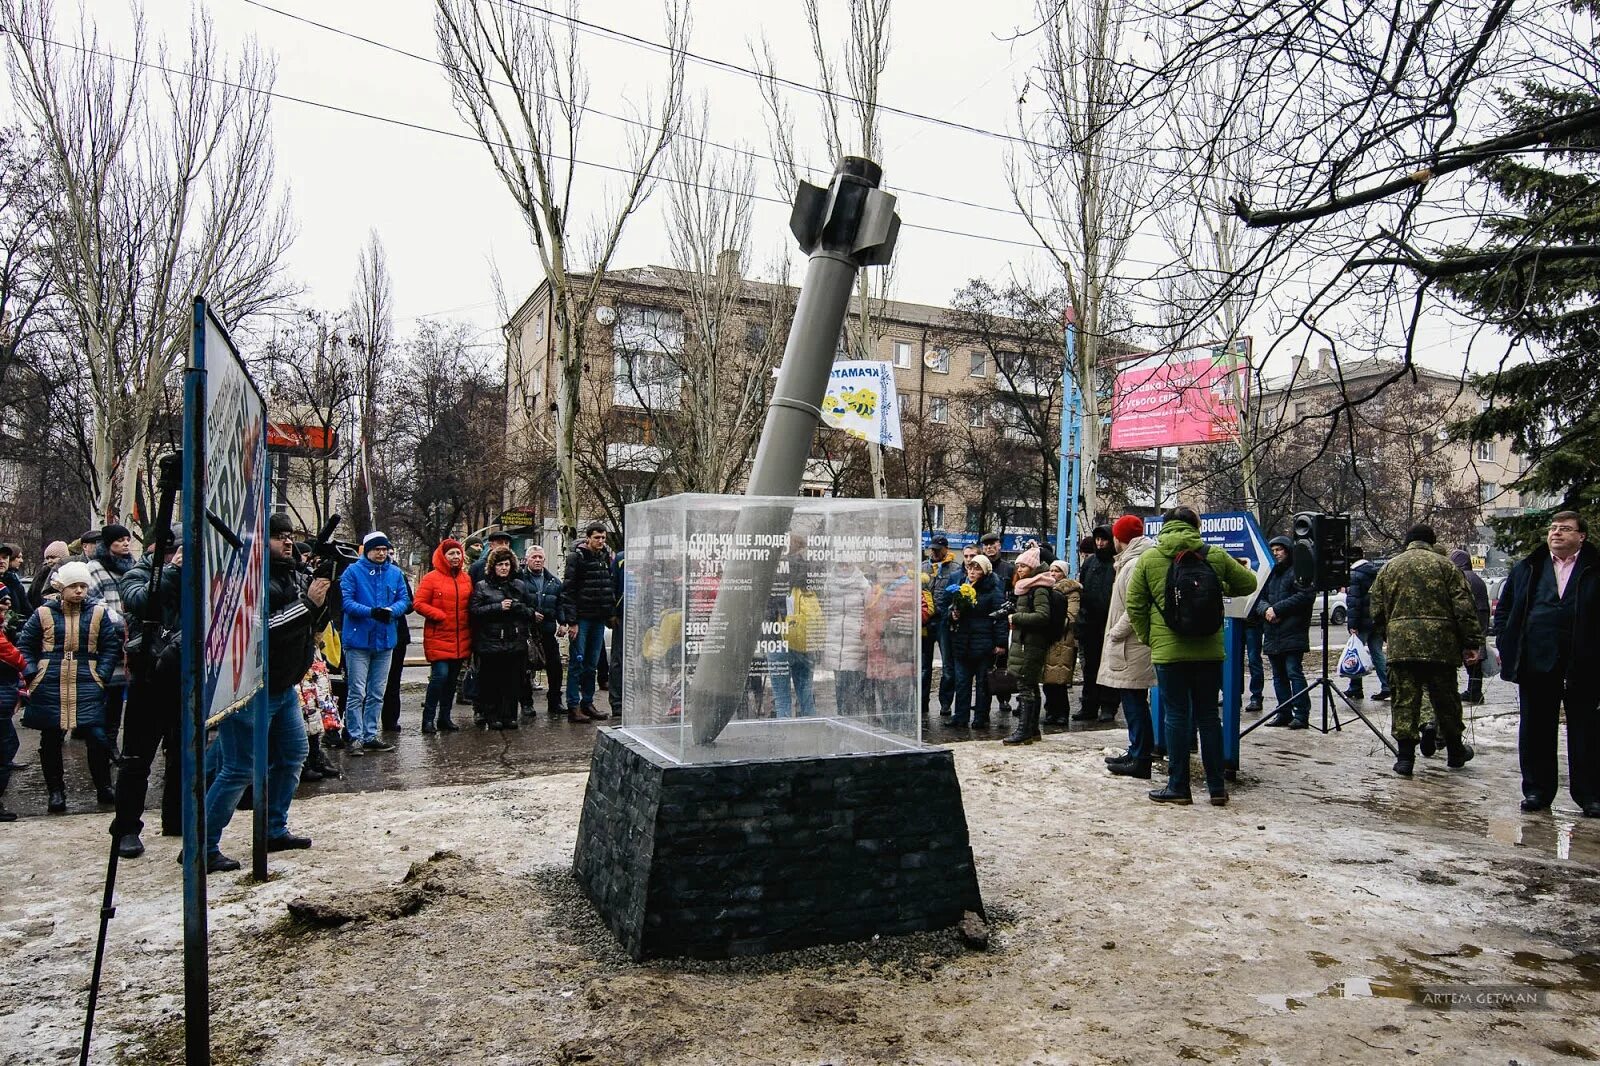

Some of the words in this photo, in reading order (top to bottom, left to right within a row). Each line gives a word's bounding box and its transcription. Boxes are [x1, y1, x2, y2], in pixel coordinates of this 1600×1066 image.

[1200, 517, 1244, 534] ВОКАТОВ
[690, 533, 733, 545] СКІЛЬКИ
[736, 534, 752, 548] ЩЕ
[754, 532, 791, 548] ЛЮДЕЙ
[807, 535, 831, 547] HOW
[834, 536, 860, 547] MANY
[861, 536, 889, 548] MORE
[714, 548, 770, 561] ЗАГИНУТИ?
[807, 550, 840, 561] PEOPLE
